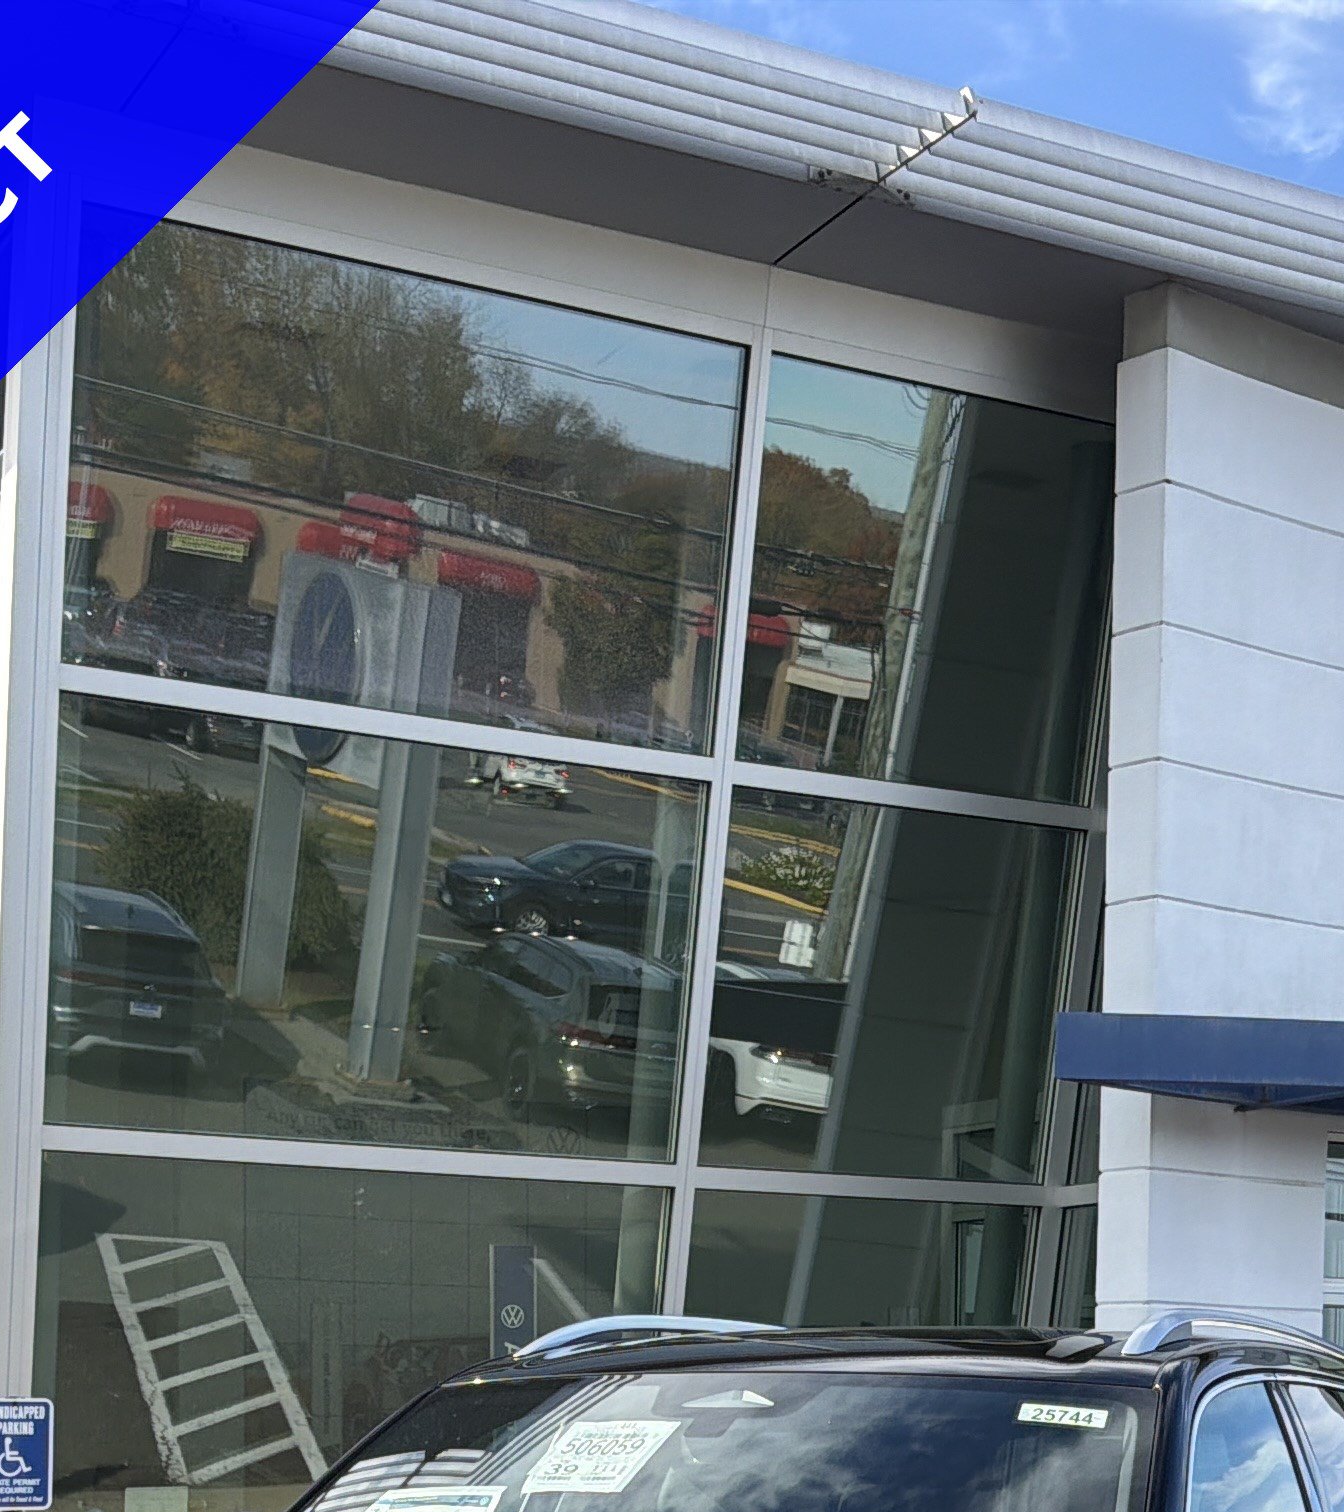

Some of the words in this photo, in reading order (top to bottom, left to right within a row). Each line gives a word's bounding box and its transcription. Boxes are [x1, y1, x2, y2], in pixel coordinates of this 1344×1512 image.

[1030, 1407, 1094, 1425] 25744
[560, 1438, 646, 1456] 506059
[544, 1463, 579, 1476] 39
[12, 1478, 42, 1487] PERMIT
